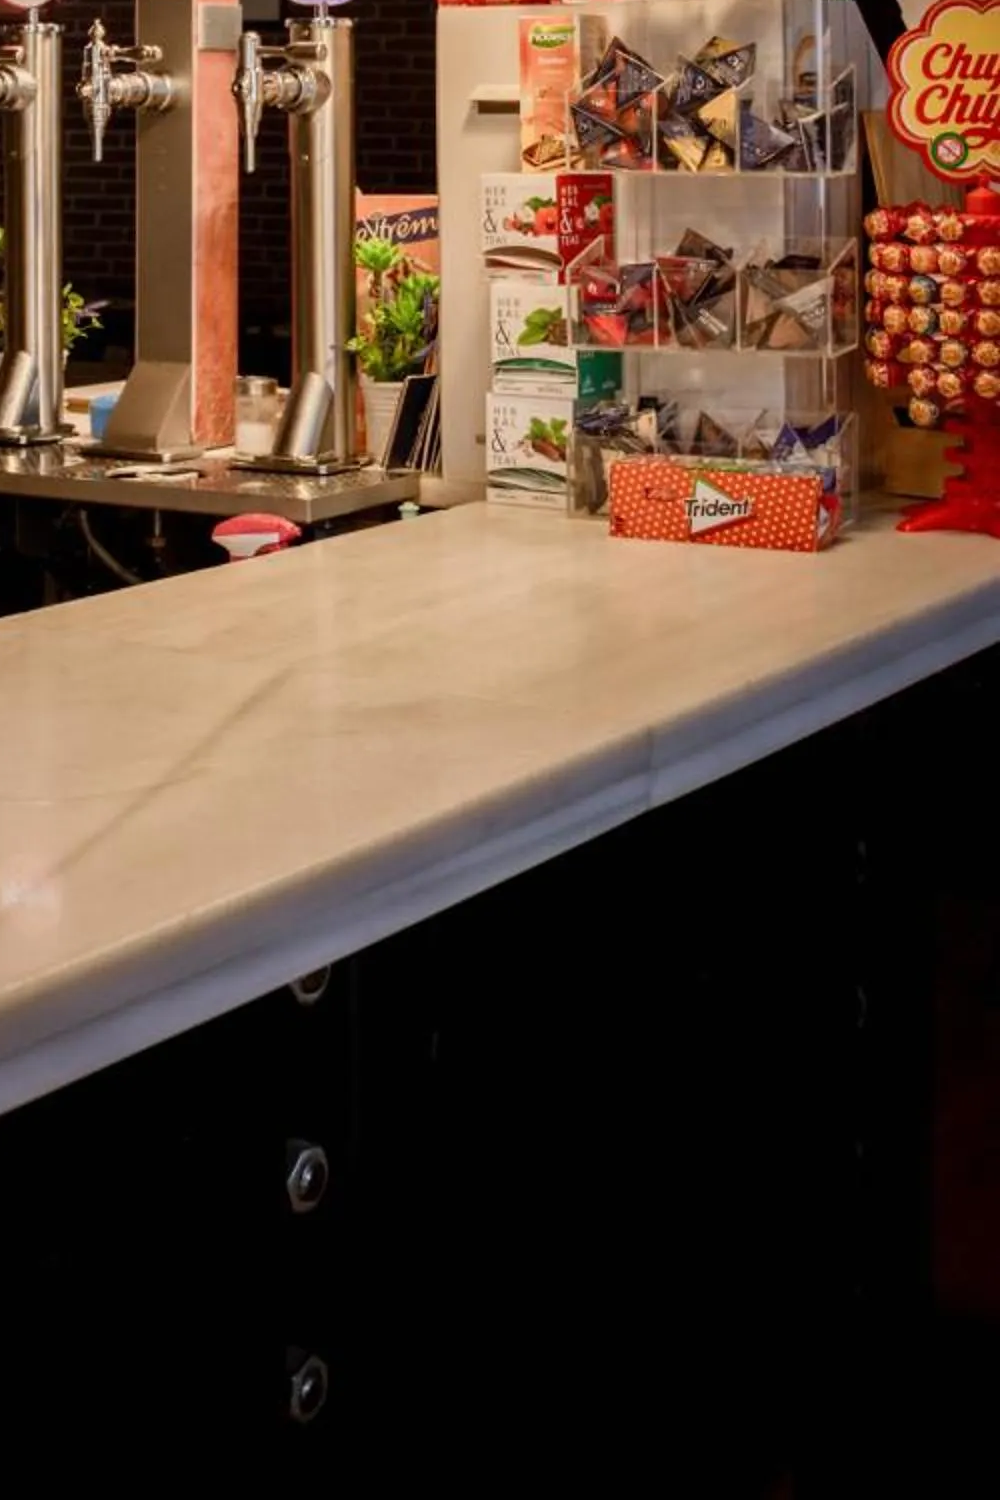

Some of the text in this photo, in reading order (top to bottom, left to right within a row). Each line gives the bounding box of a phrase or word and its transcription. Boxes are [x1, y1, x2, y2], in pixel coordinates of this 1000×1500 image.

[483, 209, 497, 233] &
[560, 208, 573, 234] &
[495, 320, 510, 346] &
[491, 429, 506, 453] &
[686, 499, 749, 518] Trident
